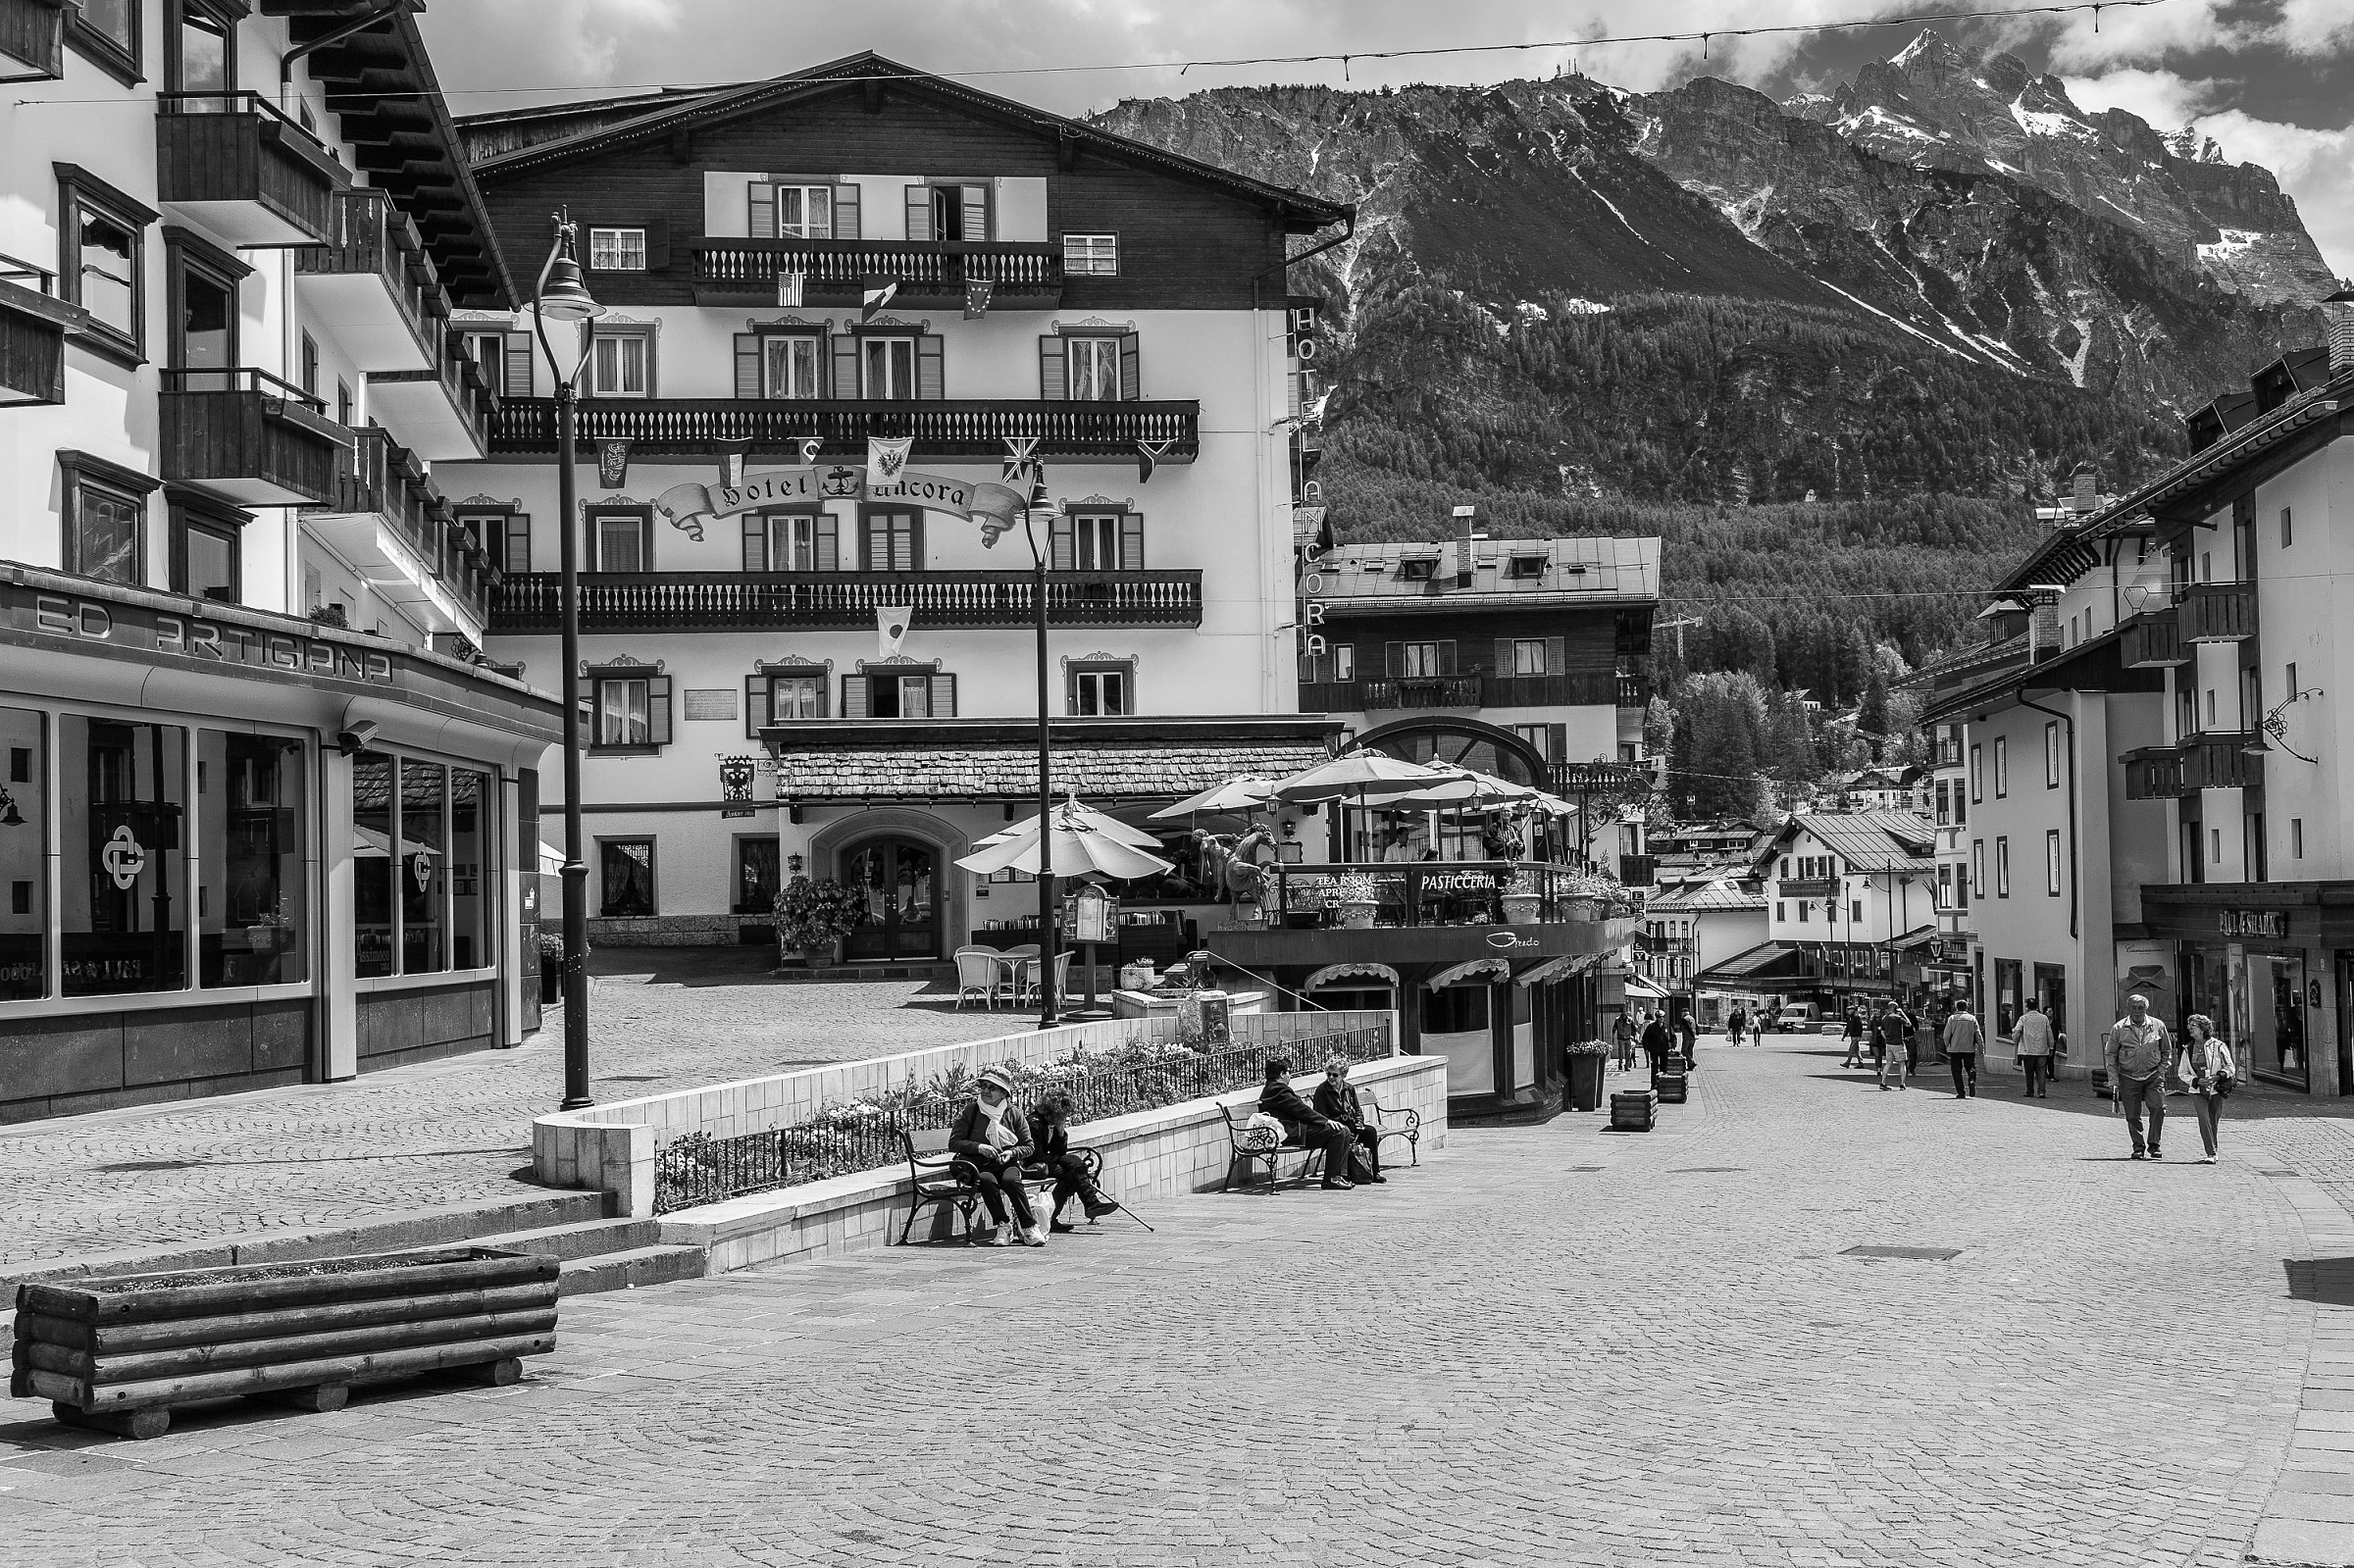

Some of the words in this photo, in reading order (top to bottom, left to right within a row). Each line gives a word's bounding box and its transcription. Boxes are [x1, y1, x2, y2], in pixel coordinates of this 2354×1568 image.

[1295, 307, 1319, 453] HOTEL
[1304, 480, 1327, 656] ANCORA
[37, 594, 114, 639] ED
[157, 616, 394, 683] ARTIGIANA
[1315, 876, 1337, 885] TEA
[1422, 875, 1496, 890] PASTICCERIA
